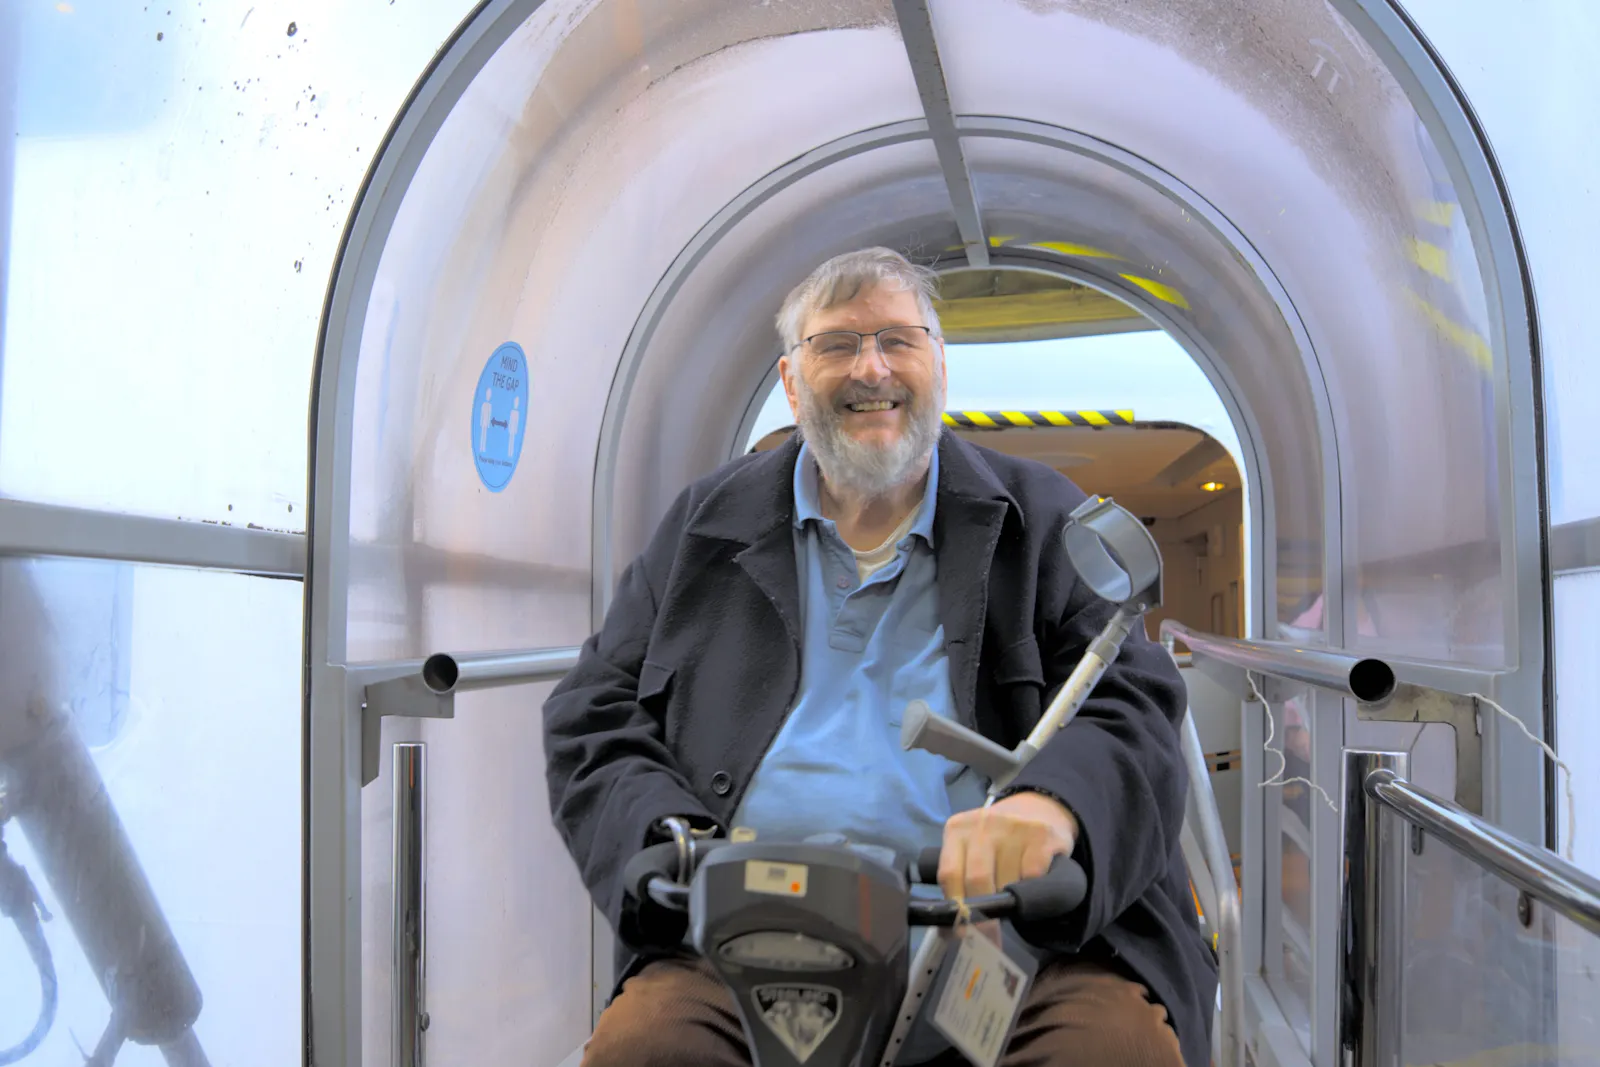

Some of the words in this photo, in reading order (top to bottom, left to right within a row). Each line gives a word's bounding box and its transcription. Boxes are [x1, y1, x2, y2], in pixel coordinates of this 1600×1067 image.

[500, 355, 518, 372] MIND
[492, 371, 505, 389] THE
[505, 376, 520, 392] GAP
